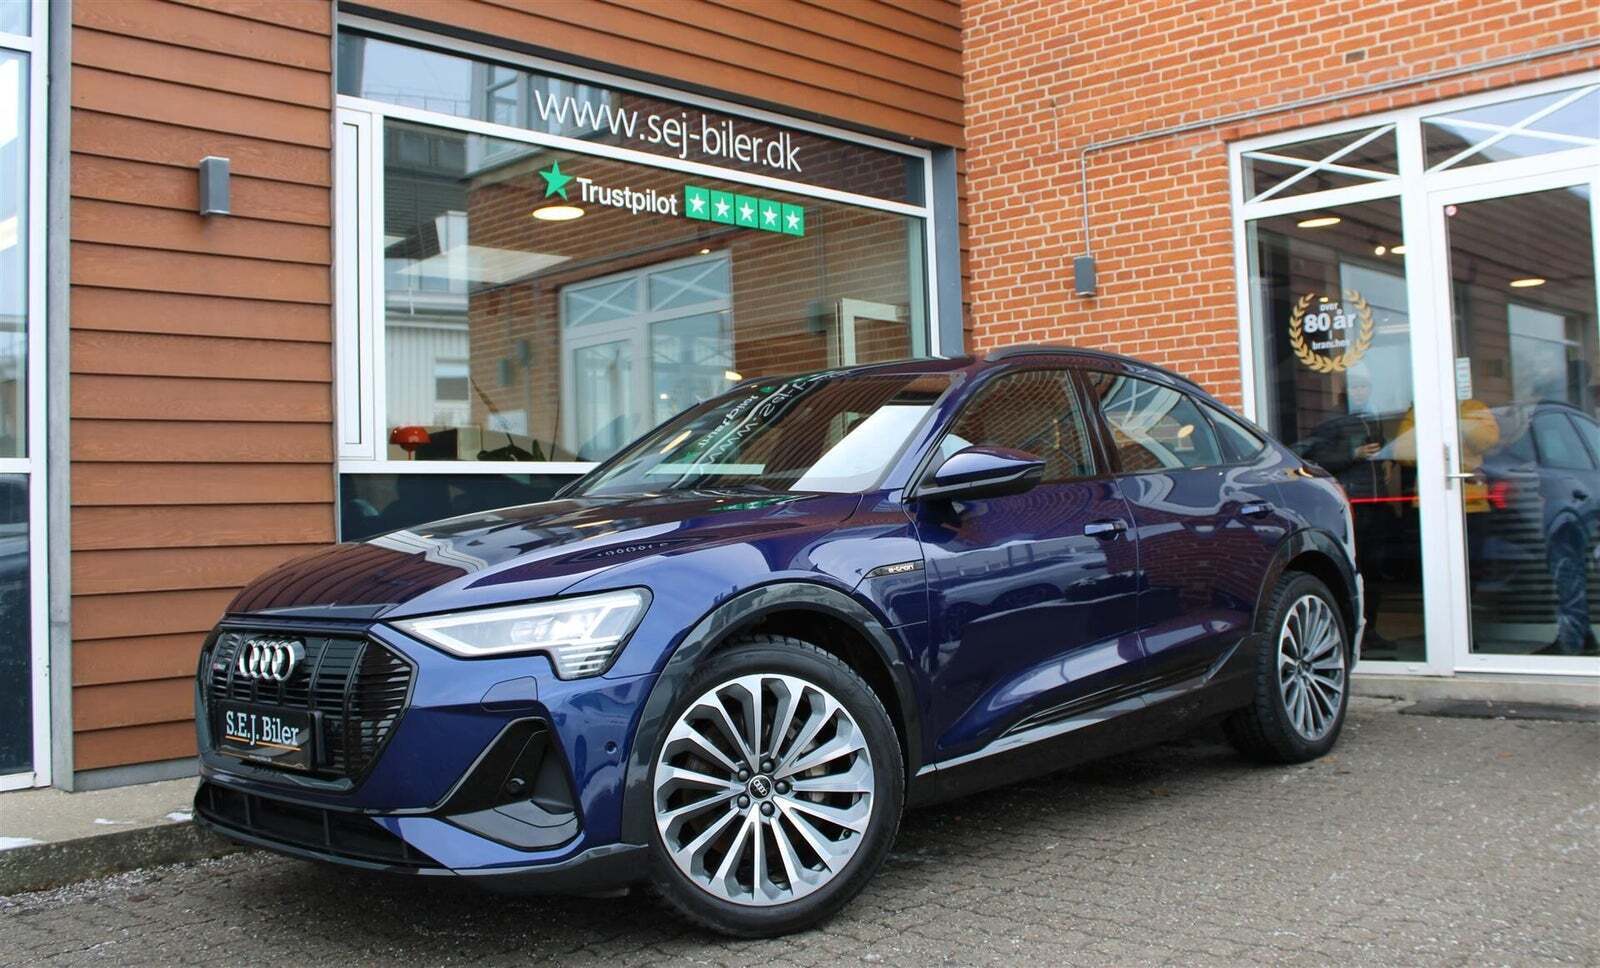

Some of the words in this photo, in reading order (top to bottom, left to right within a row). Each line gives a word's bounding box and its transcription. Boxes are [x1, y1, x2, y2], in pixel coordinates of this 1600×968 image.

[534, 89, 803, 173] www.sej-biler.dk
[576, 177, 678, 216] Trustpilot
[1304, 313, 1331, 333] 80
[1333, 308, 1357, 330] år
[1320, 303, 1339, 312] over
[226, 710, 260, 746] S.E.J.
[262, 716, 299, 746] Biler
